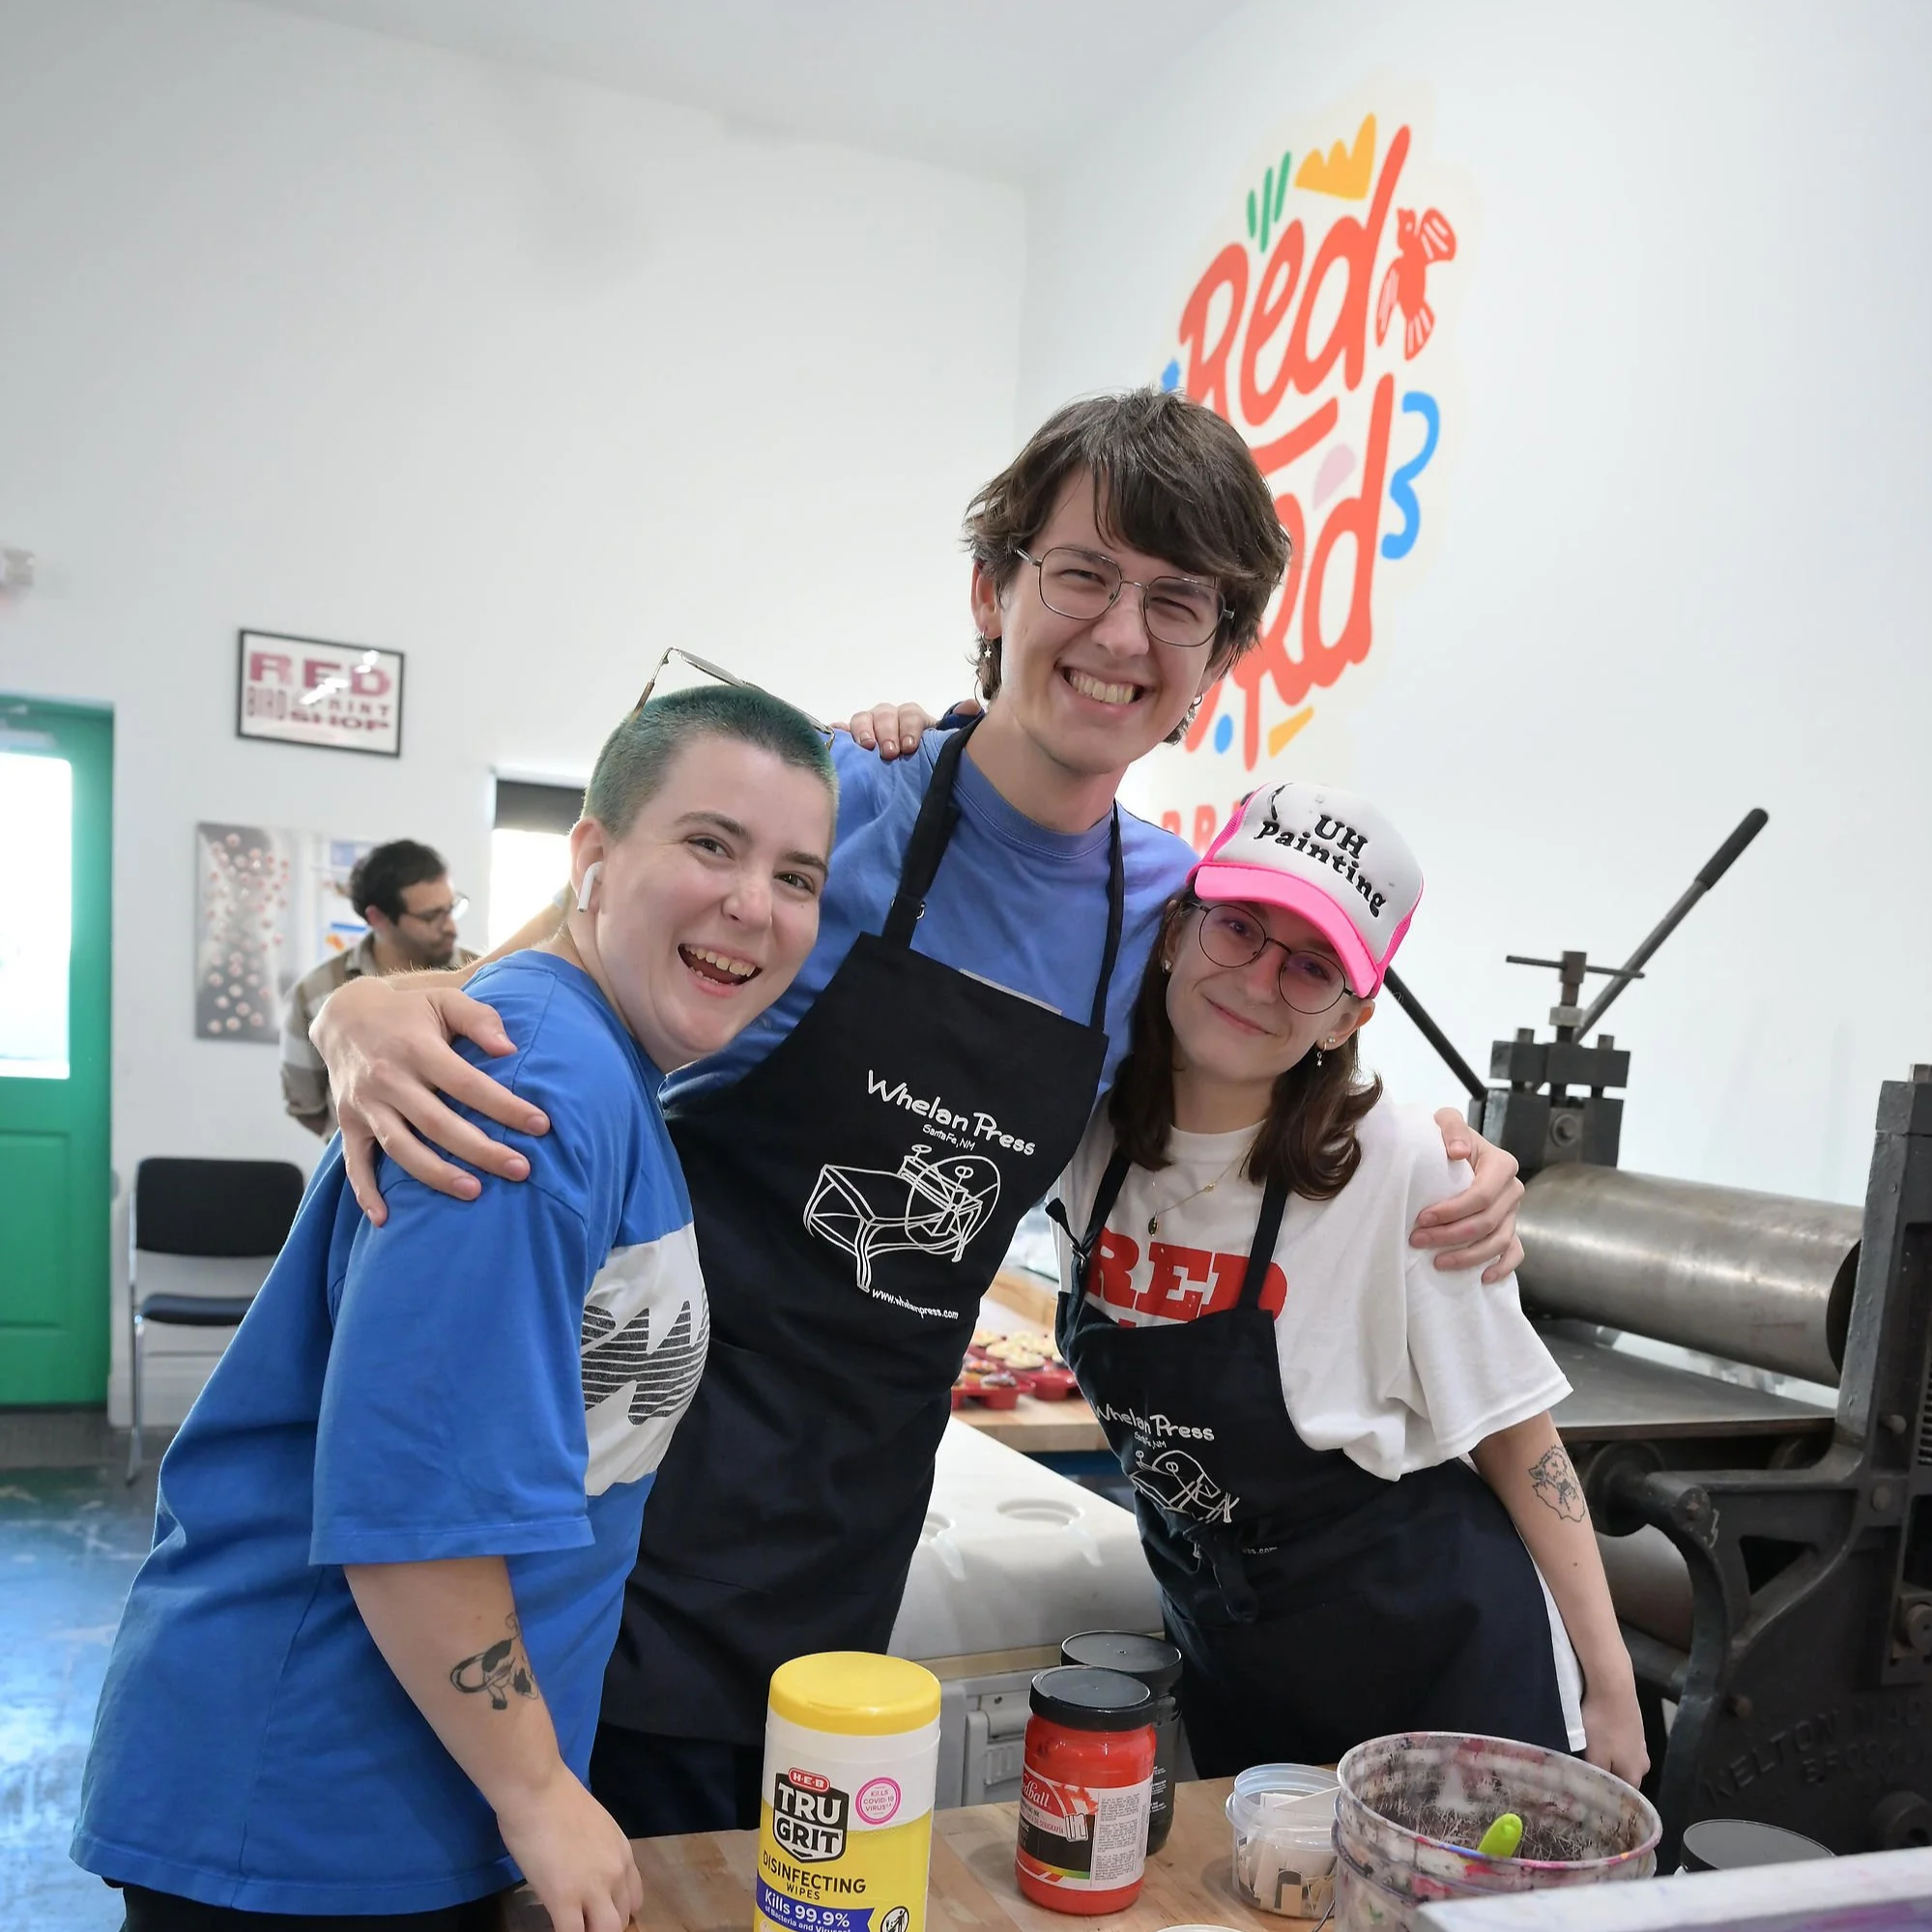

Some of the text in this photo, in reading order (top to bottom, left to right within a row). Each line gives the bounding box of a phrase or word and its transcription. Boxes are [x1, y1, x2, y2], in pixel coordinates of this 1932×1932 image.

[1177, 124, 1411, 426] Red
[1314, 814, 1368, 859] UH
[1254, 820, 1386, 918] Painting
[867, 1069, 1035, 1156] Whelan Press
[960, 1138, 975, 1151] NM
[1090, 1399, 1151, 1434] Whelan
[1149, 1414, 1215, 1441] Press
[778, 1783, 842, 1825] TRU
[863, 1796, 894, 1804] COVID-19
[776, 1817, 839, 1854] GRIT
[763, 1850, 866, 1893] DISINFECTING
[787, 1883, 820, 1900] WIPES
[764, 1889, 851, 1927] Kills 99.9%
[770, 1908, 796, 1926] Bacteria
[798, 1921, 813, 1931] and
